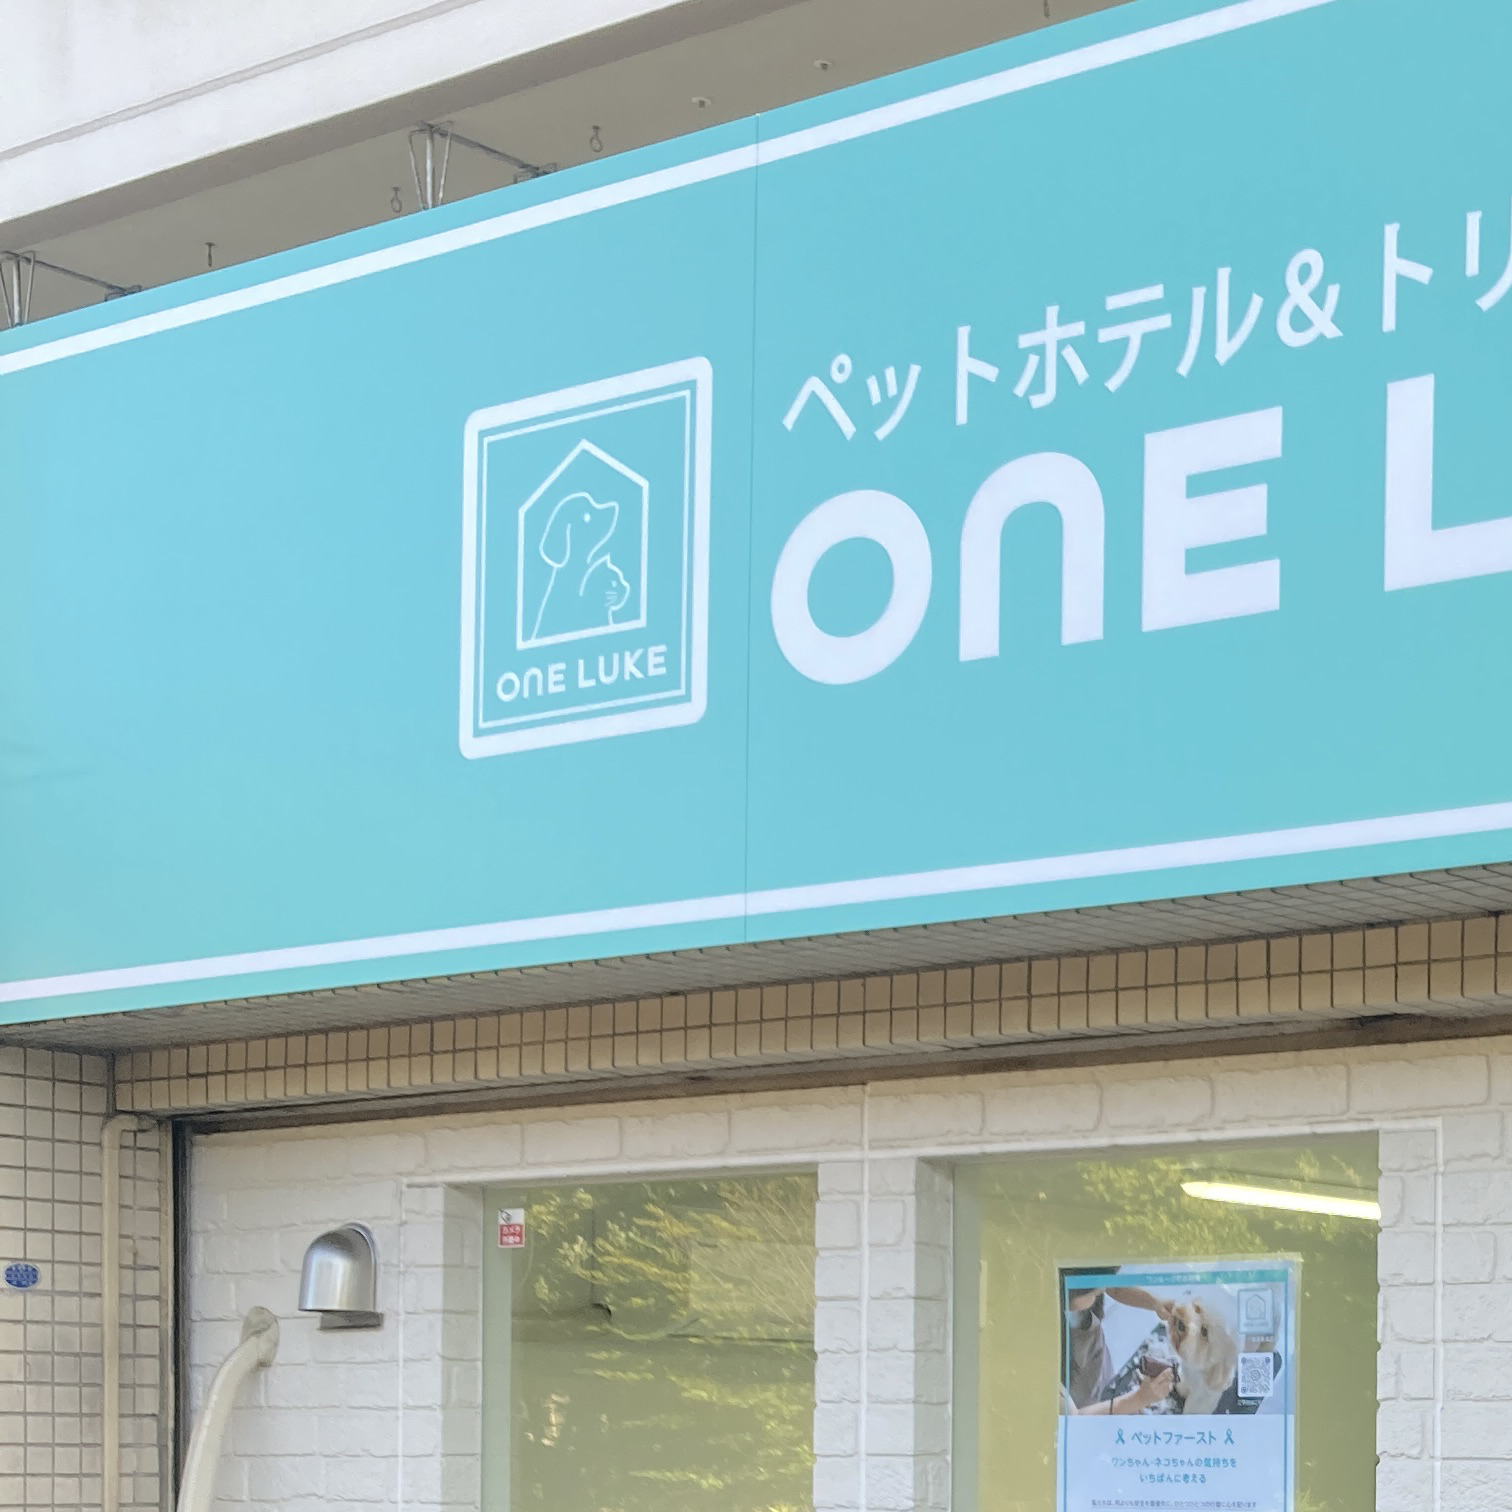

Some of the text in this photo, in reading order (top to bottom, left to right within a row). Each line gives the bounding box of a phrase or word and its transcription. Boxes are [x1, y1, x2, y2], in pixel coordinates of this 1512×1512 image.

[770, 405, 1284, 686] ONE
[496, 644, 667, 702] ONE LUKE
[1130, 1429, 1217, 1445] ペットファースト
[1139, 1472, 1207, 1484] いちばんに考える
